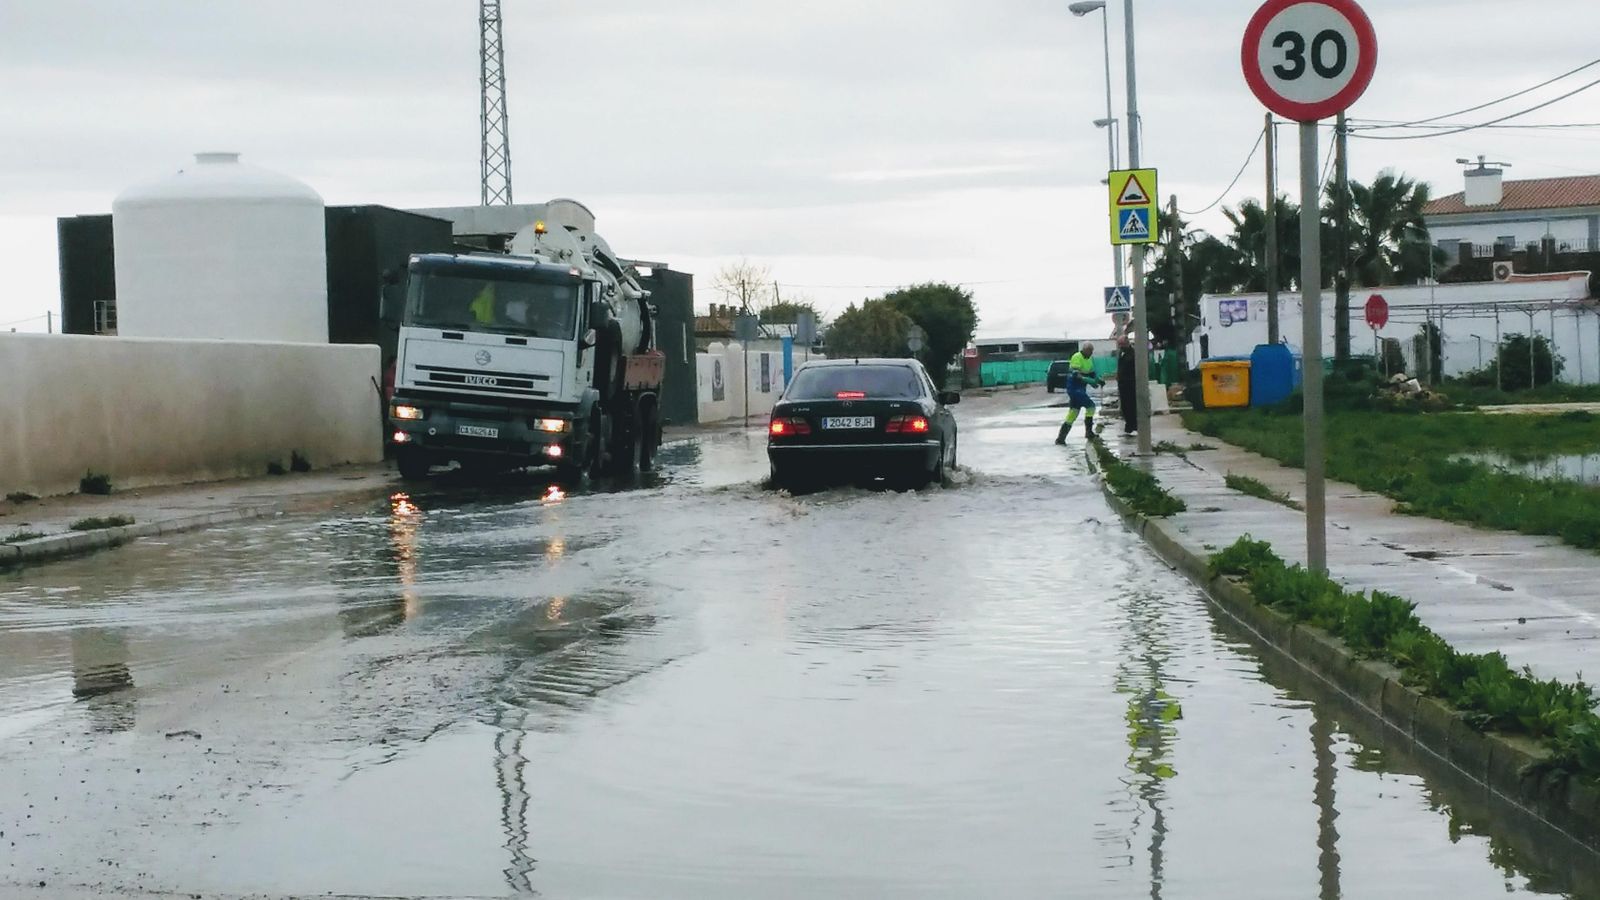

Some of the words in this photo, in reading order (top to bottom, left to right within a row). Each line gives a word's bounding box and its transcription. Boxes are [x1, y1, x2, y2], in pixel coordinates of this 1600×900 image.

[1272, 29, 1347, 81] 30
[465, 376, 498, 385] IVECO
[829, 419, 852, 428] 2042
[854, 419, 873, 427] BJH
